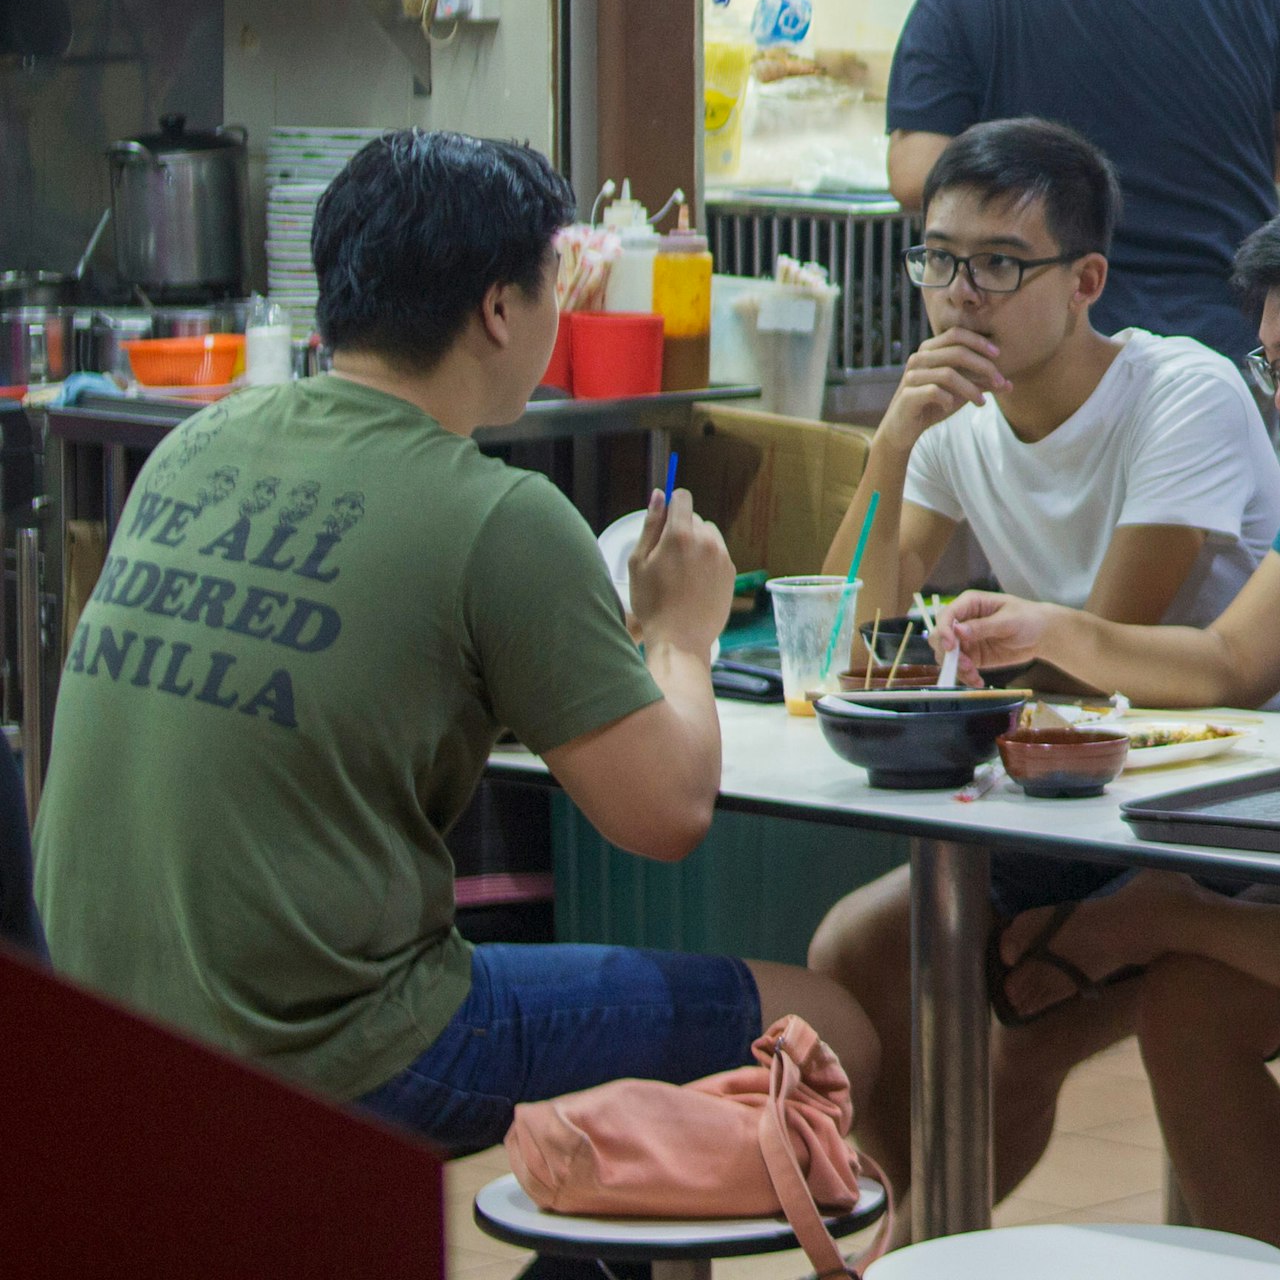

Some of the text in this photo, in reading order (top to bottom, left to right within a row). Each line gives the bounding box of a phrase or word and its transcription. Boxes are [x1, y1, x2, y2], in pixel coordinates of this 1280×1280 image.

[127, 491, 342, 584] WE ALL
[93, 555, 342, 654] RDERED
[66, 622, 298, 729] ANILLA
